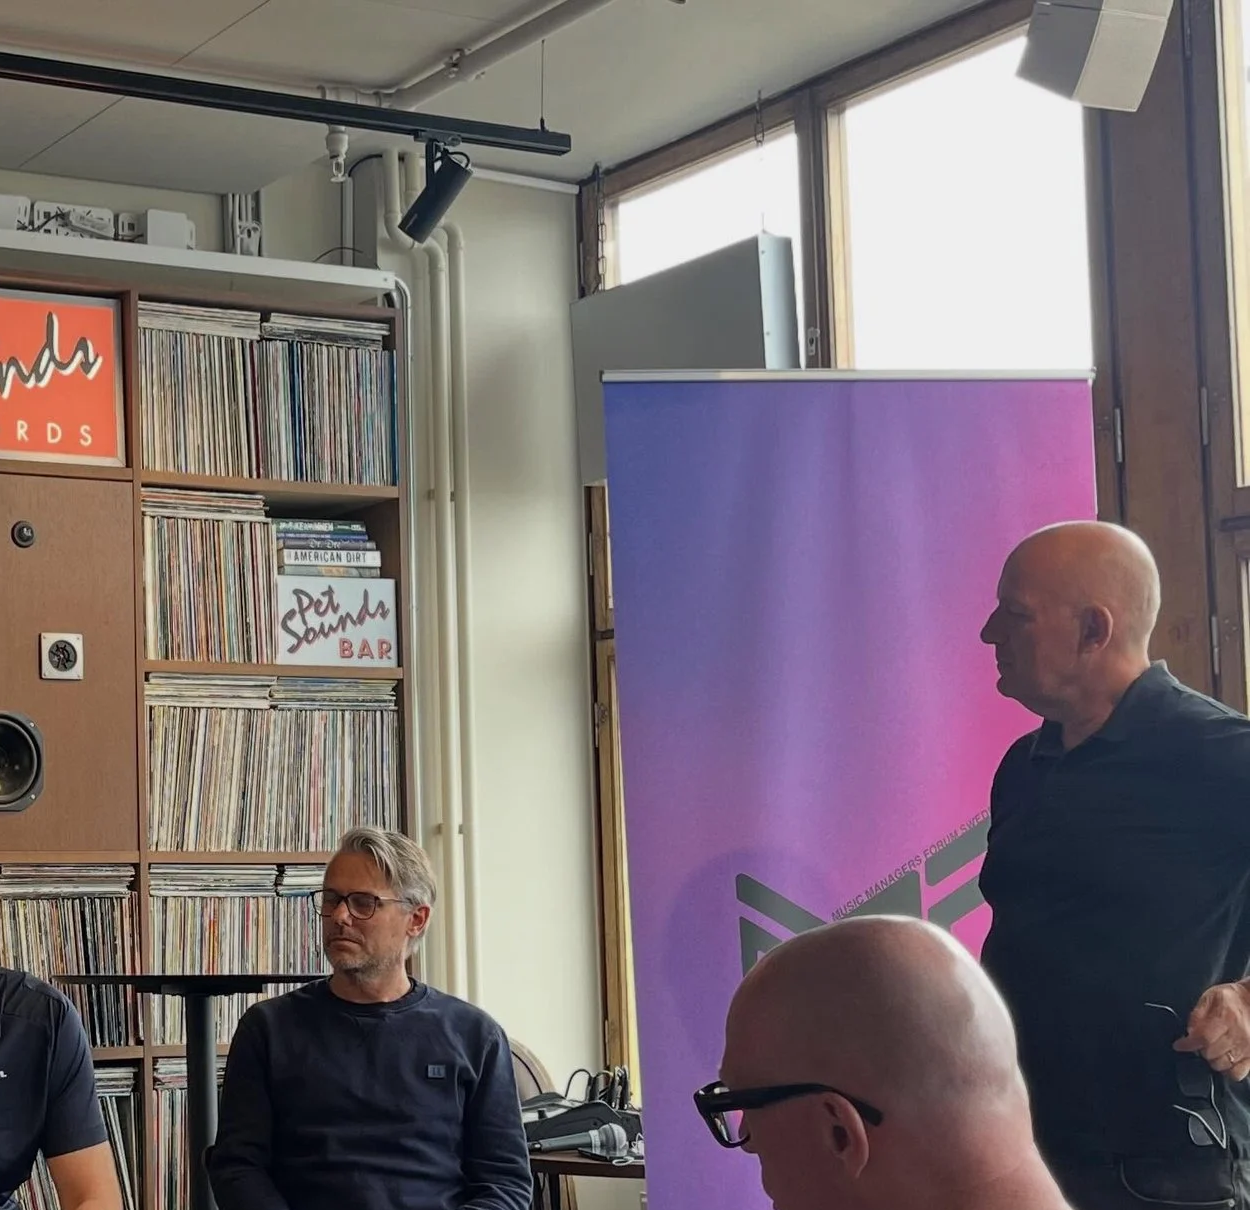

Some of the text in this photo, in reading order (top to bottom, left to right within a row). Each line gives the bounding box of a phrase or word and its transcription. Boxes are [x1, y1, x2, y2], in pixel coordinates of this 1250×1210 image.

[293, 551, 367, 564] AMERICAN DIRT
[280, 589, 390, 654] Sounds
[292, 584, 340, 625] Pet
[338, 637, 393, 660] BAR
[830, 806, 990, 922] MUSIC MANAGERS FORUM SWED
